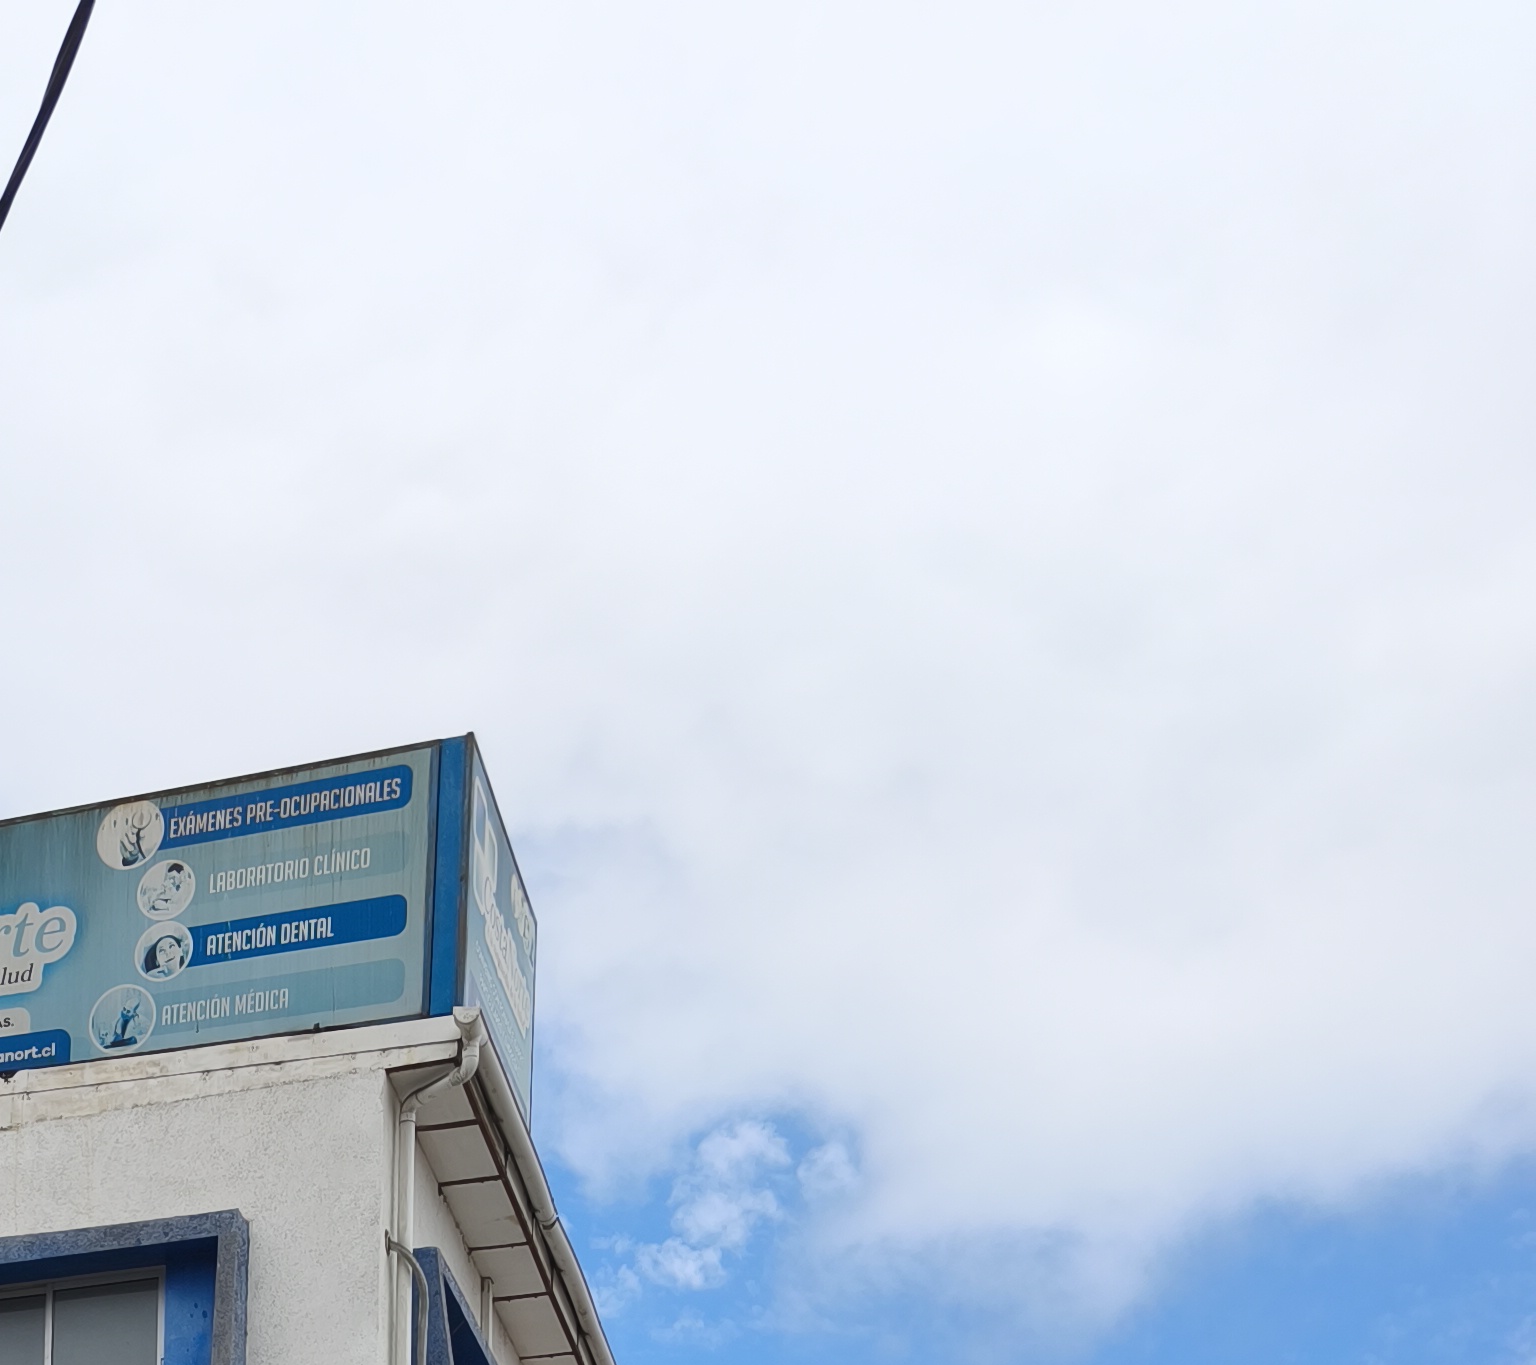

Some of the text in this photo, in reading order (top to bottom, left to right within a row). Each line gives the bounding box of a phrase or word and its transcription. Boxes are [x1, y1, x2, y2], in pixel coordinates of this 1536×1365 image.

[169, 778, 402, 839] EXÁMENES PRE-OCUPACIONALES
[209, 847, 371, 894] LABORATORIO CLÍNICO
[206, 916, 334, 957] ATENCIÓN DENTAL
[161, 986, 289, 1026] ATENCIÓN MÉDICA
